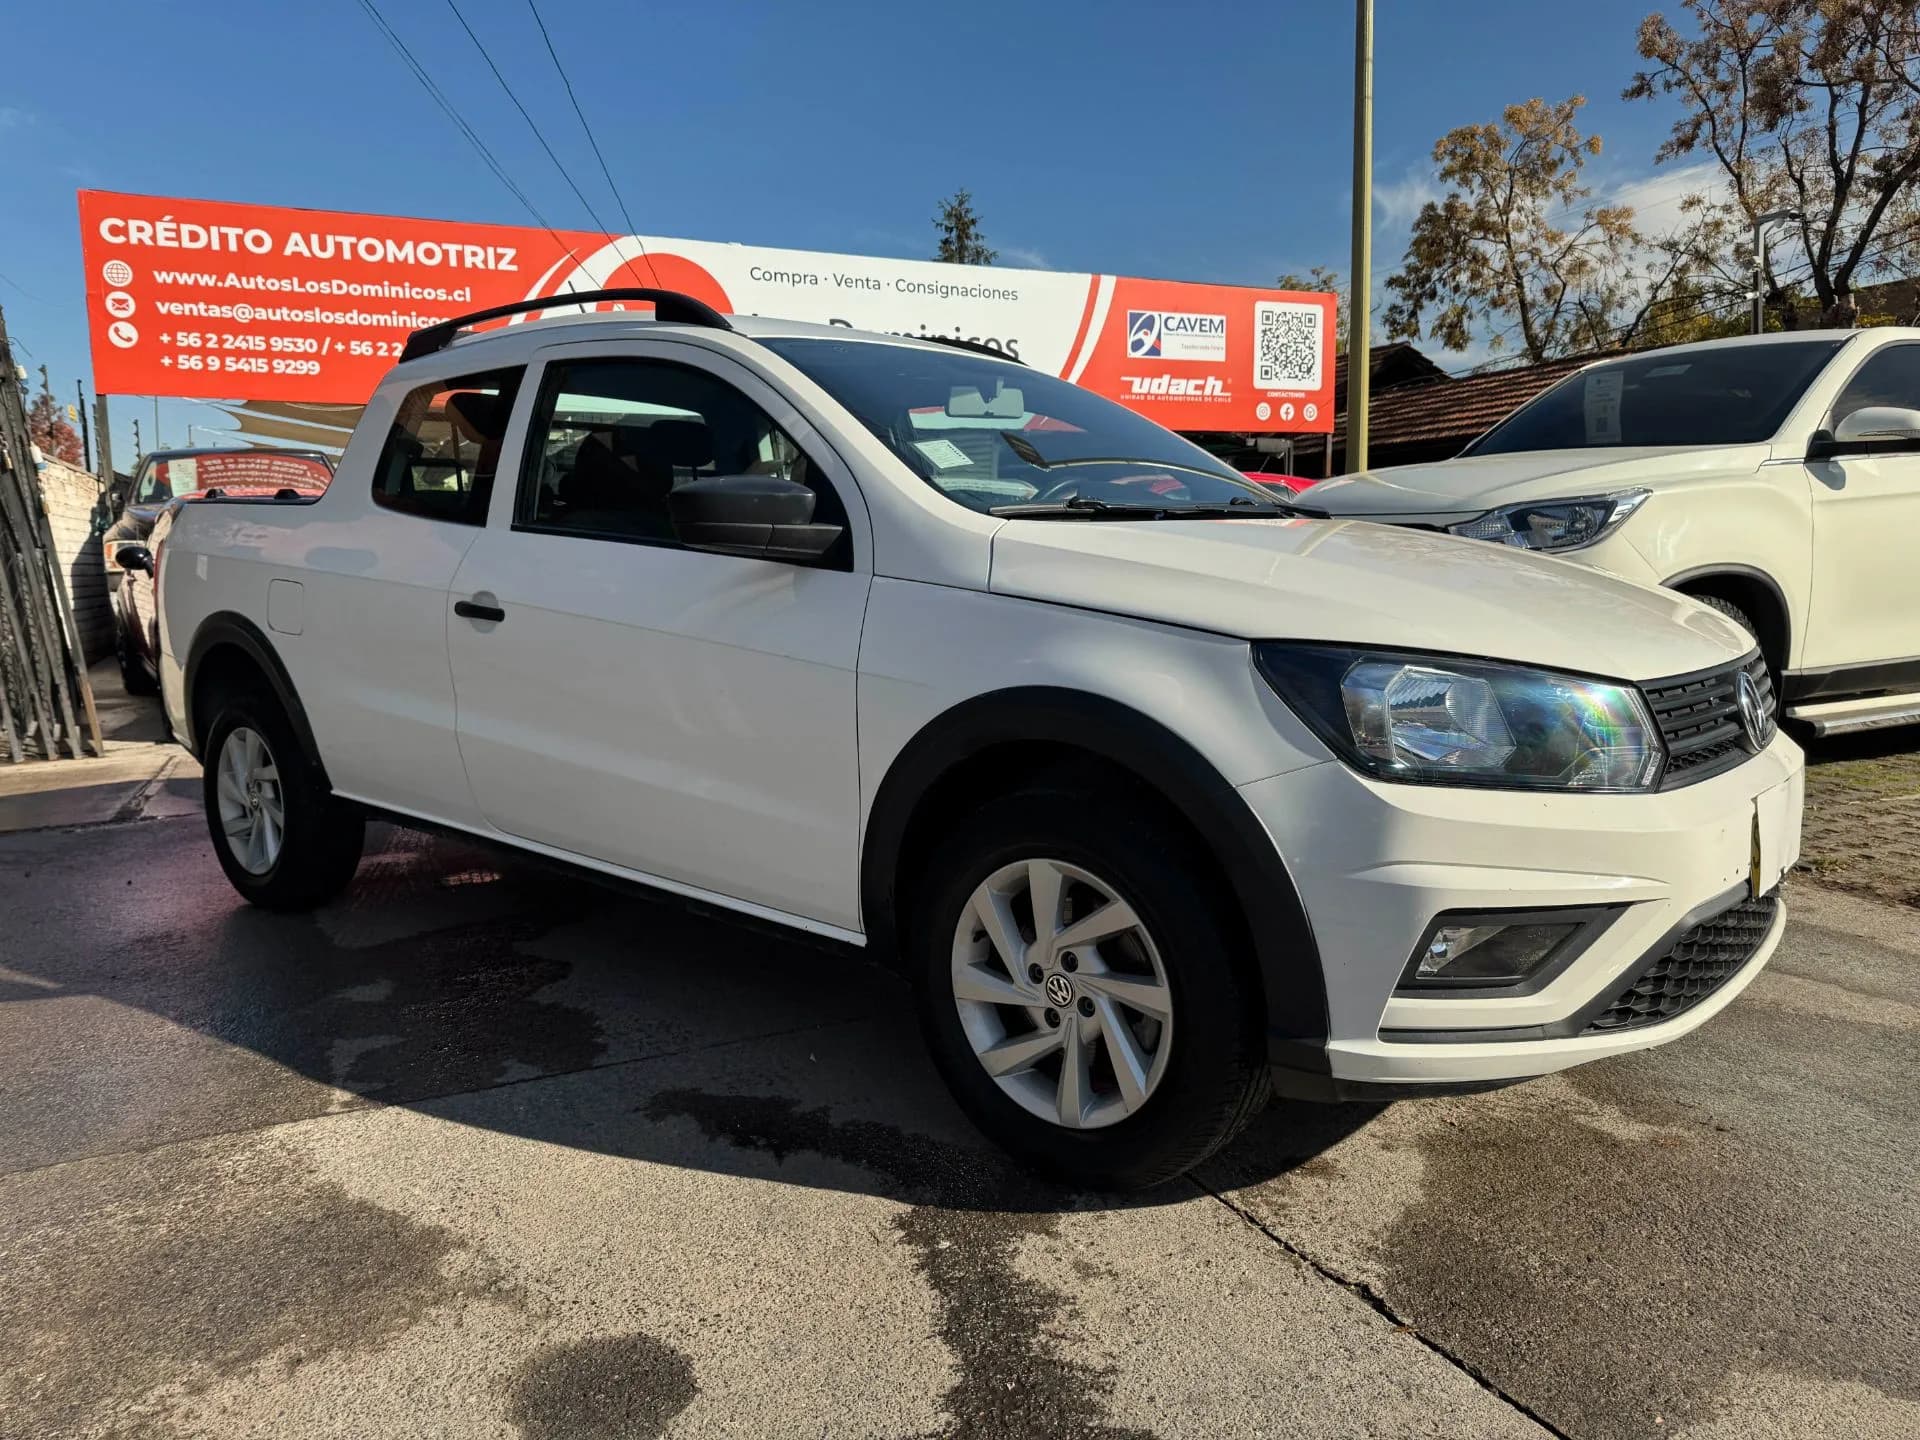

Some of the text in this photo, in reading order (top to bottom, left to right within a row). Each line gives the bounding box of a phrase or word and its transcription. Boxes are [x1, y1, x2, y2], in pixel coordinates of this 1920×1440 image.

[99, 215, 519, 272] CRÉDITO AUTOMOTRIZ
[153, 270, 472, 302] www.AutosLosDominicos.cl
[749, 266, 818, 287] Compra
[832, 273, 881, 291] Venta
[895, 278, 1019, 301] Consignaciones
[1163, 316, 1224, 334] CAVEM
[176, 331, 203, 348] 56
[205, 333, 219, 349] 2
[221, 334, 267, 351] 2415
[269, 336, 319, 353] 9530
[349, 340, 374, 356] 56
[376, 342, 389, 357] 2
[177, 354, 204, 371] 56
[206, 356, 221, 371] 9
[224, 357, 270, 373] 5415
[271, 359, 321, 376] 9299
[1120, 374, 1232, 396] udach
